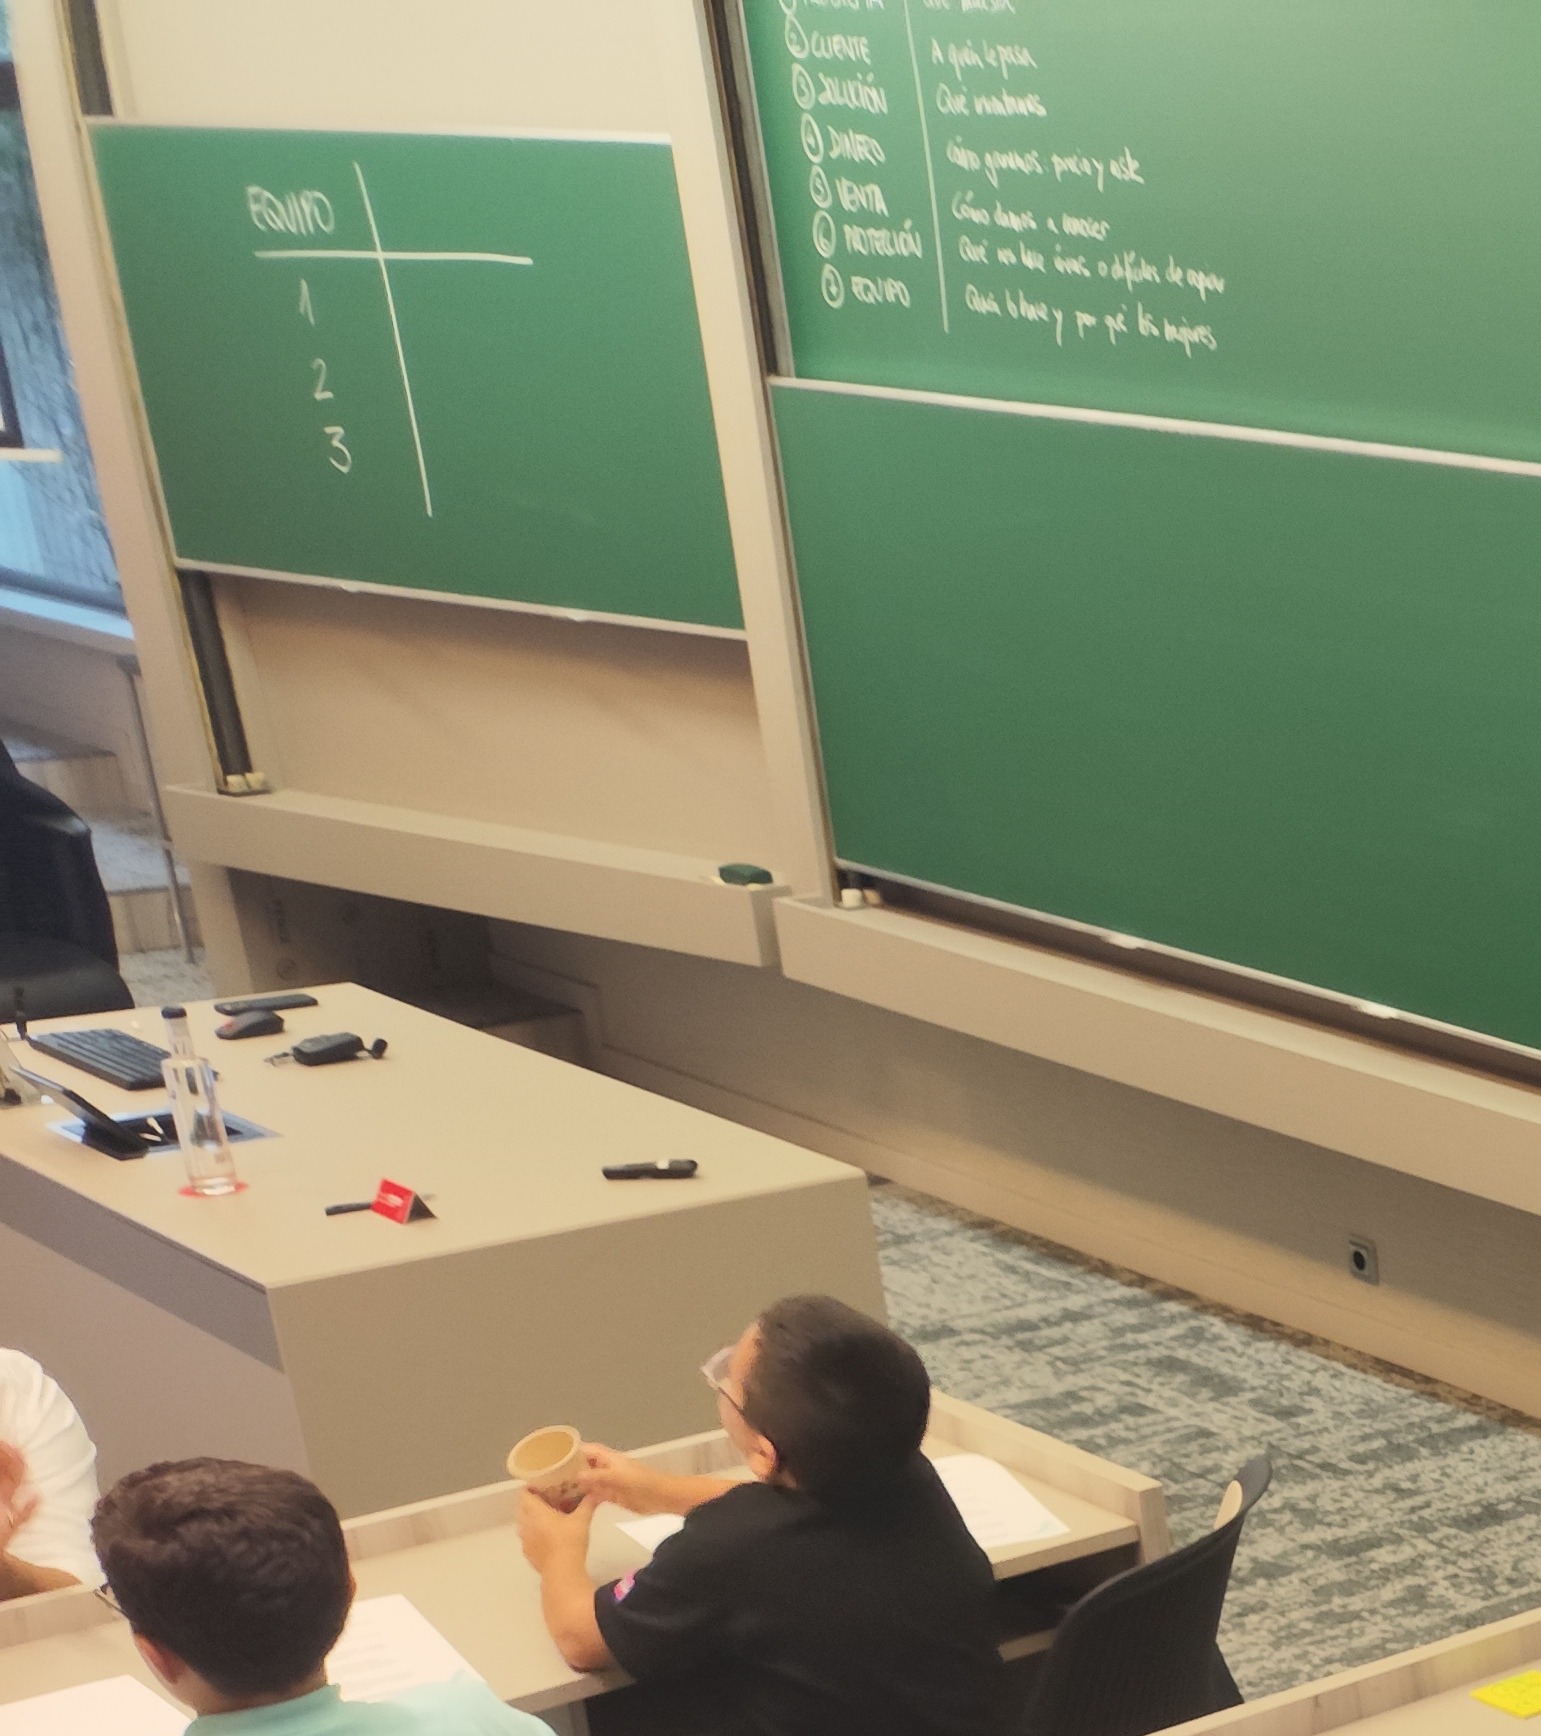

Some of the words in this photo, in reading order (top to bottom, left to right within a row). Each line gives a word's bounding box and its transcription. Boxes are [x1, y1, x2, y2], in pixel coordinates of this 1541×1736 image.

[812, 30, 871, 65] CLIENTE
[298, 278, 316, 326] 1
[310, 357, 334, 401] 2
[323, 425, 352, 474] 3
